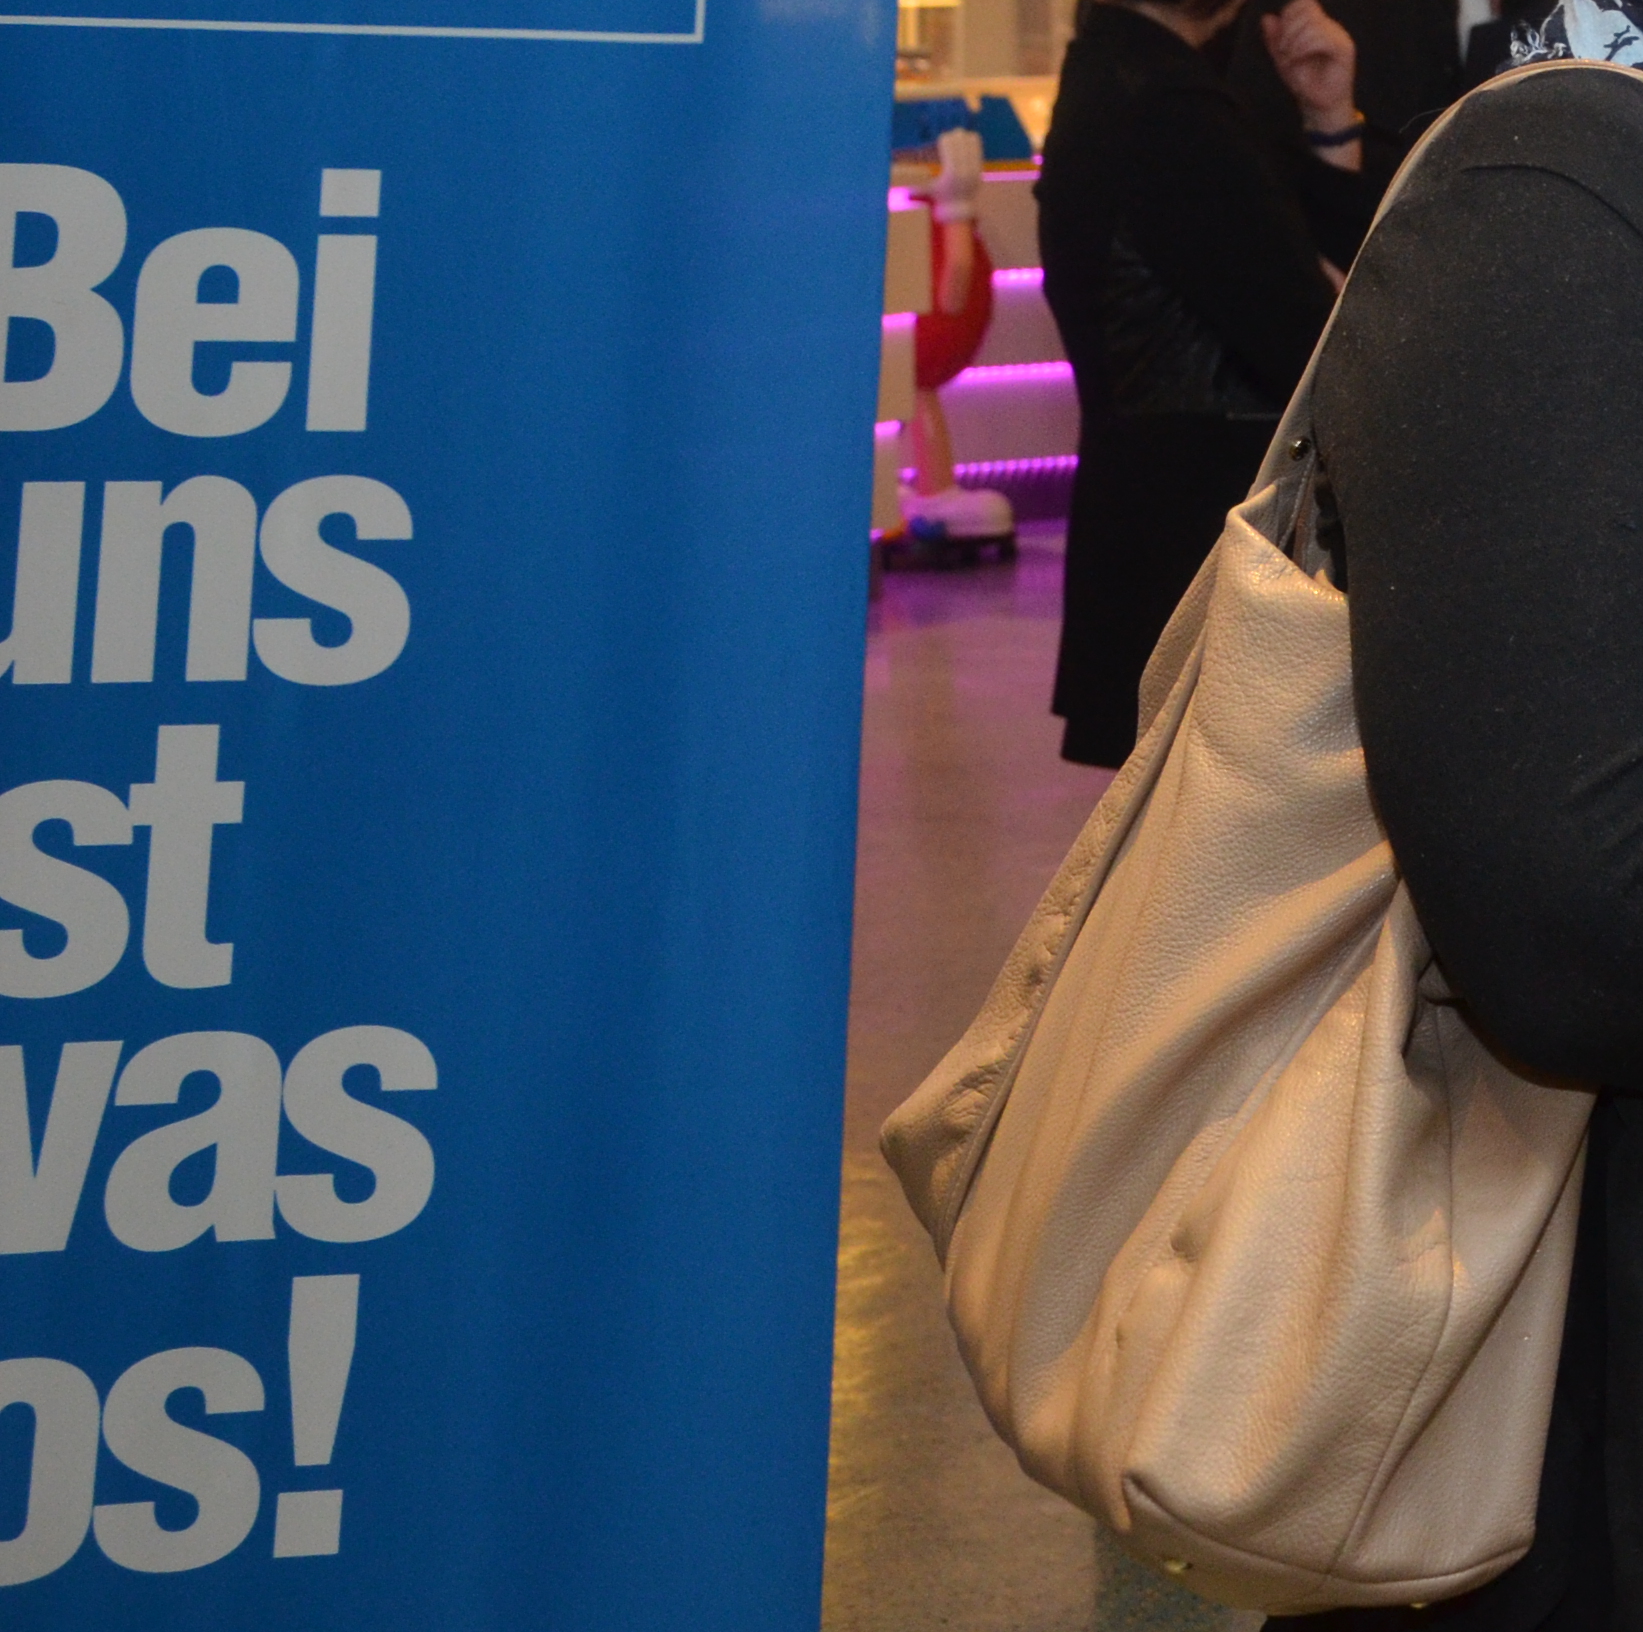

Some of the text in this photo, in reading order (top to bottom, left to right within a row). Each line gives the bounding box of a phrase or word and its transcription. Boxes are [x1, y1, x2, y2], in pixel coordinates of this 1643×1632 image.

[0, 162, 383, 438] Bei
[0, 723, 246, 999] st
[0, 1273, 361, 1581] os!
